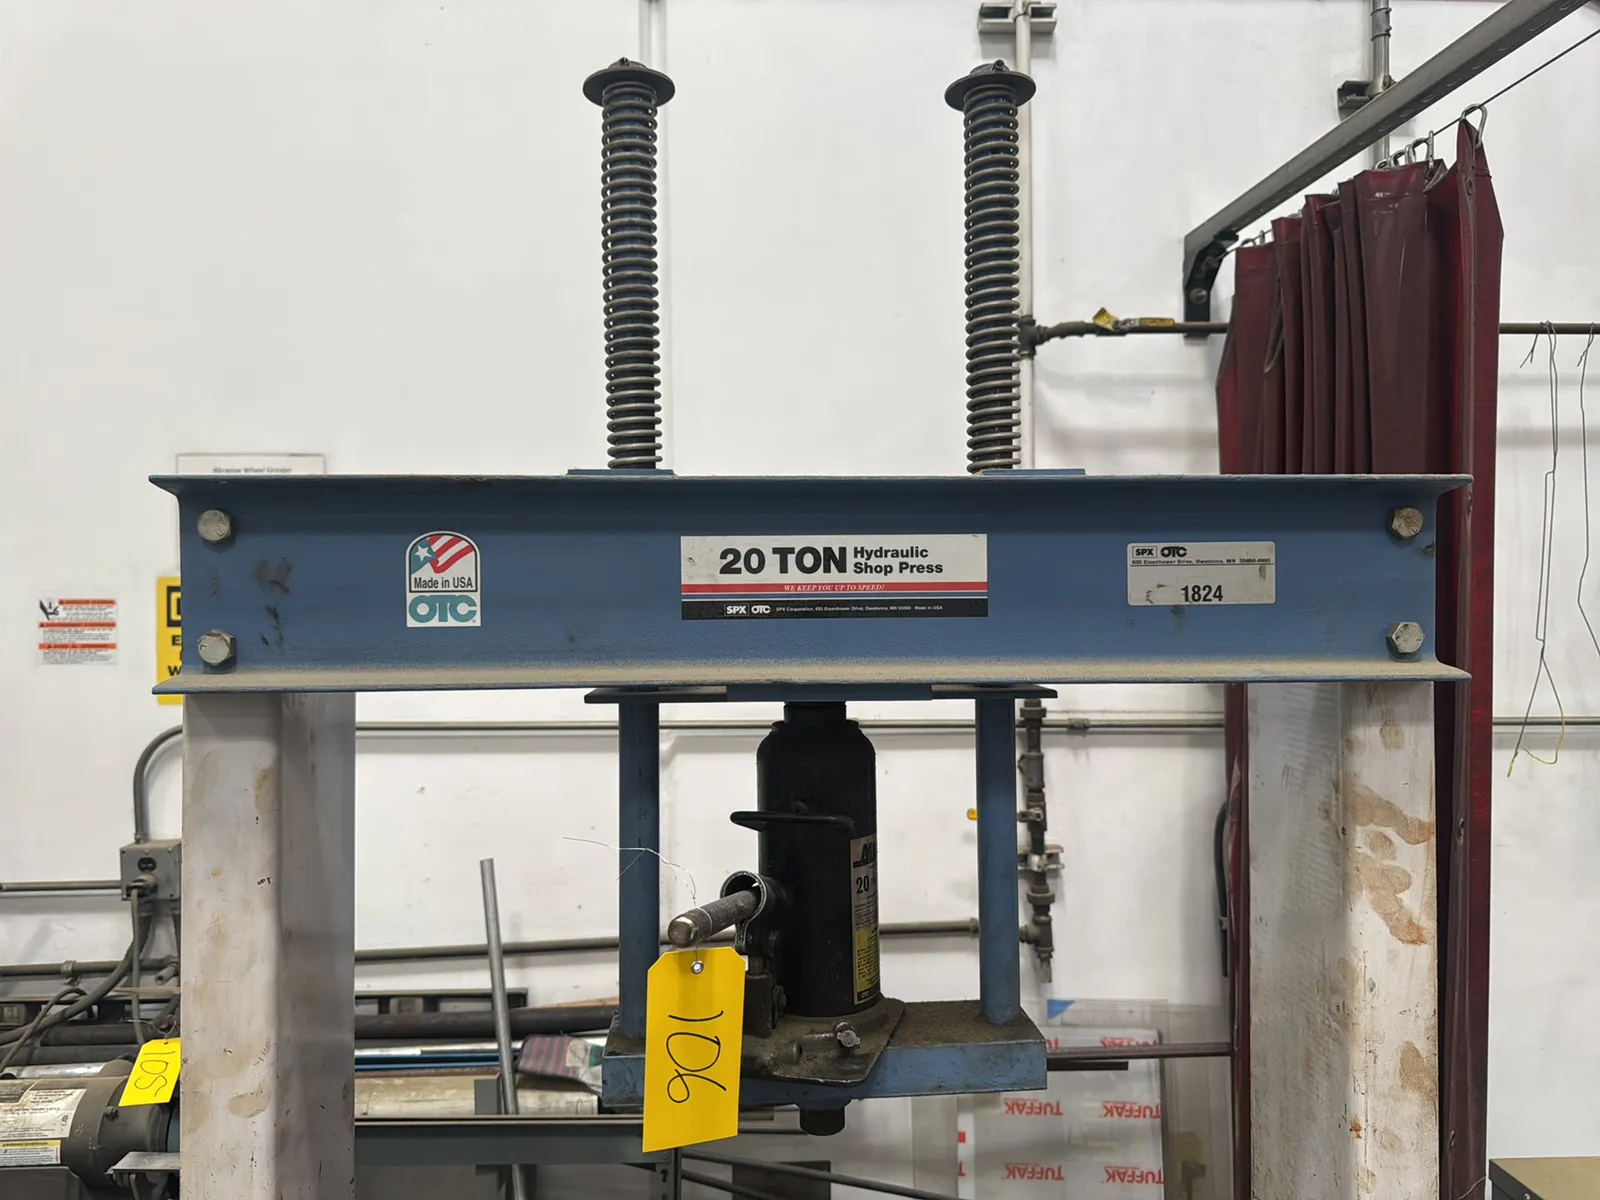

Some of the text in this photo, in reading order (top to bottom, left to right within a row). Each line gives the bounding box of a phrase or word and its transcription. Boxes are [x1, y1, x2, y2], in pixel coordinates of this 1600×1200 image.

[853, 546, 929, 560] Hydraulic
[1135, 546, 1188, 558] SPX OTC
[719, 546, 847, 575] 20 TON
[853, 561, 944, 576] Shop Press
[413, 576, 474, 589] Made in USA
[796, 584, 818, 592] KEEP
[817, 584, 833, 592] YOU
[1180, 584, 1224, 602] 1824
[408, 594, 478, 623] OTC
[726, 605, 771, 614] SPX OTC
[855, 875, 870, 894] 20
[665, 1010, 727, 1104] 106
[134, 1050, 176, 1098] 105
[1003, 1100, 1064, 1116] TUFFAK
[1102, 1103, 1161, 1119] TUFFAK
[1004, 1165, 1065, 1181] TUFFAK
[1104, 1168, 1165, 1184] TUFFAK
